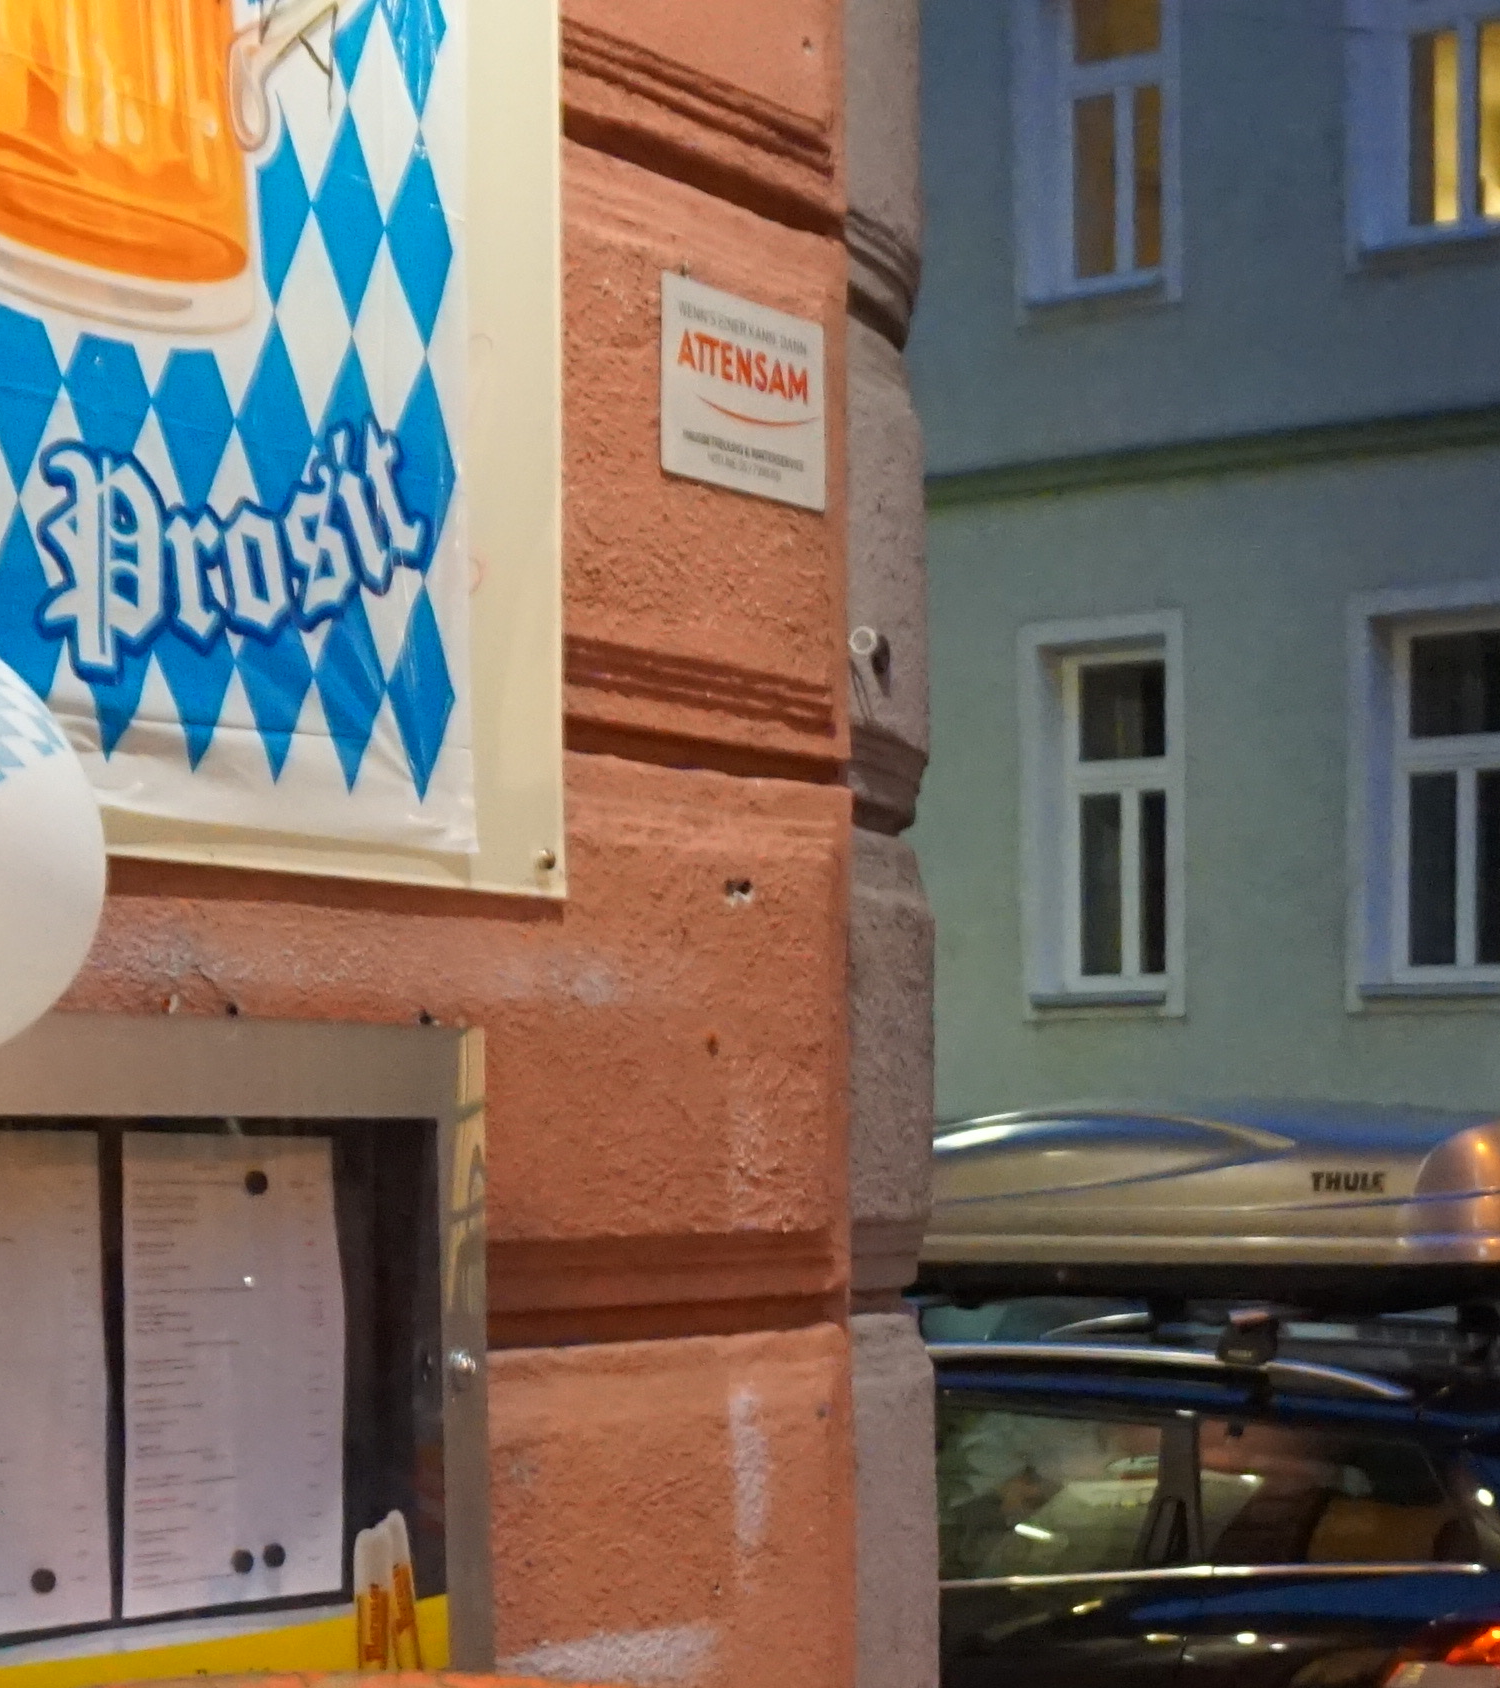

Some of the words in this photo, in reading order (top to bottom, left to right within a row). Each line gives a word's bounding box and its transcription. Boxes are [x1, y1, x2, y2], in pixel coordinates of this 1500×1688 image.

[677, 328, 808, 404] ATTENSAM
[37, 413, 433, 685] Prosit
[1311, 1171, 1386, 1194] THULE
